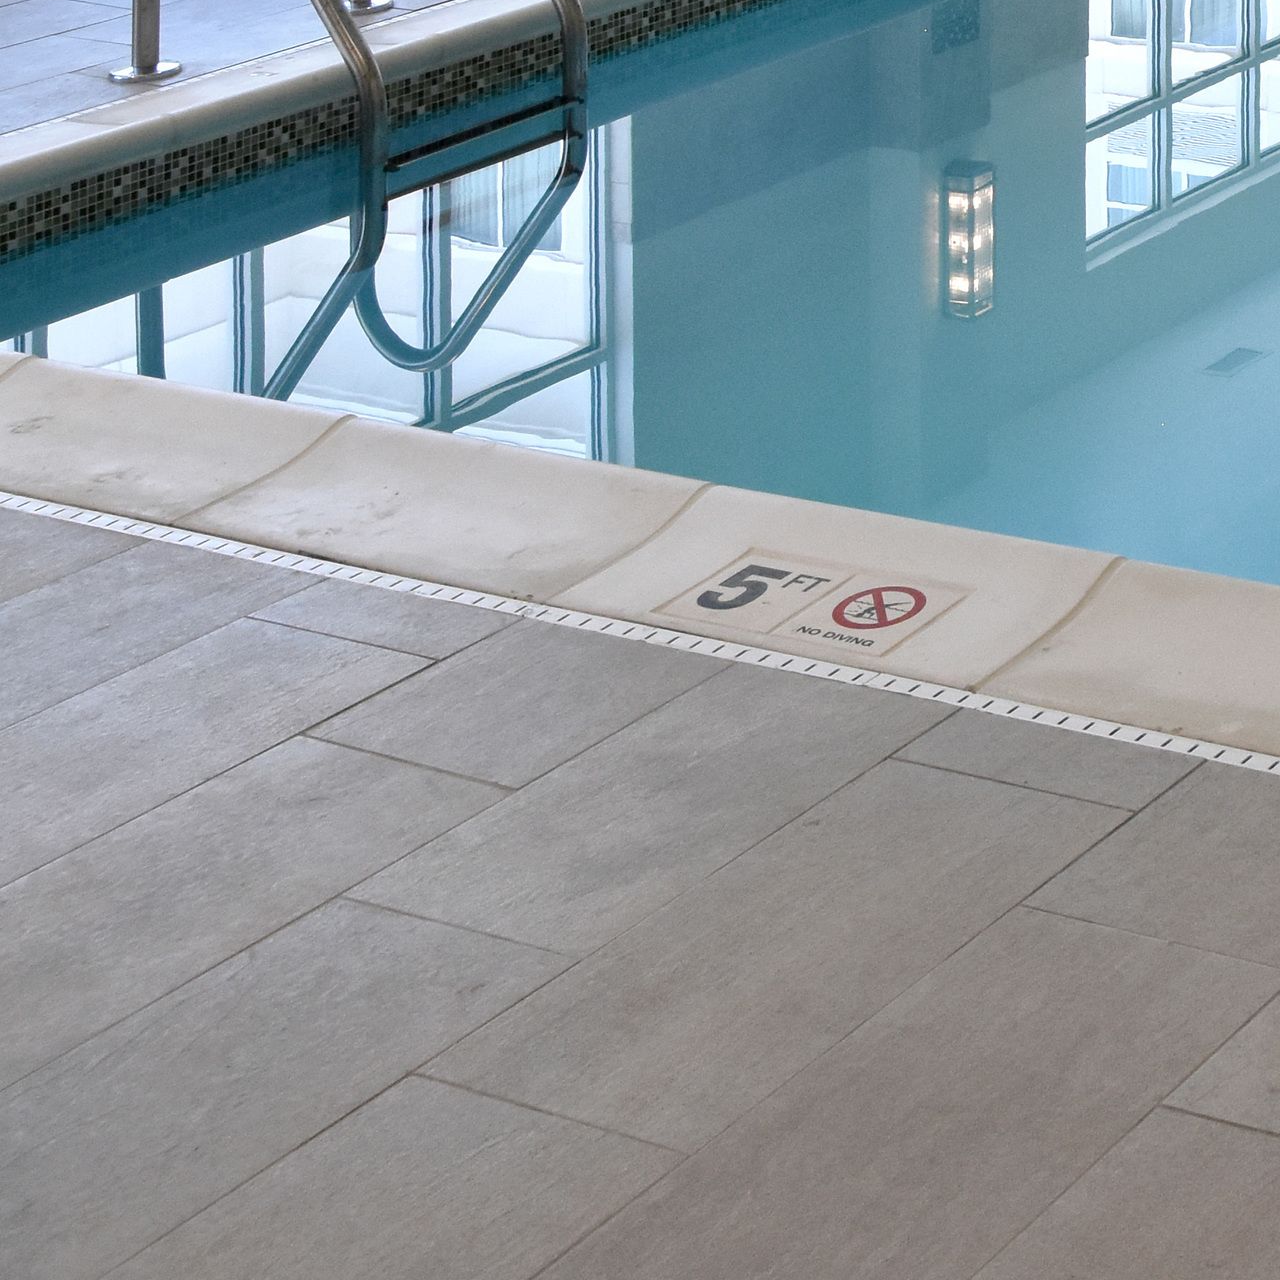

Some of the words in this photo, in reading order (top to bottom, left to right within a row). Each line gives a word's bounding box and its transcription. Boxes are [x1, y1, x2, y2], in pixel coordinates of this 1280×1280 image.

[696, 563, 793, 611] 5
[781, 573, 832, 593] FT
[796, 625, 822, 637] NO
[822, 631, 875, 647] DIVING
